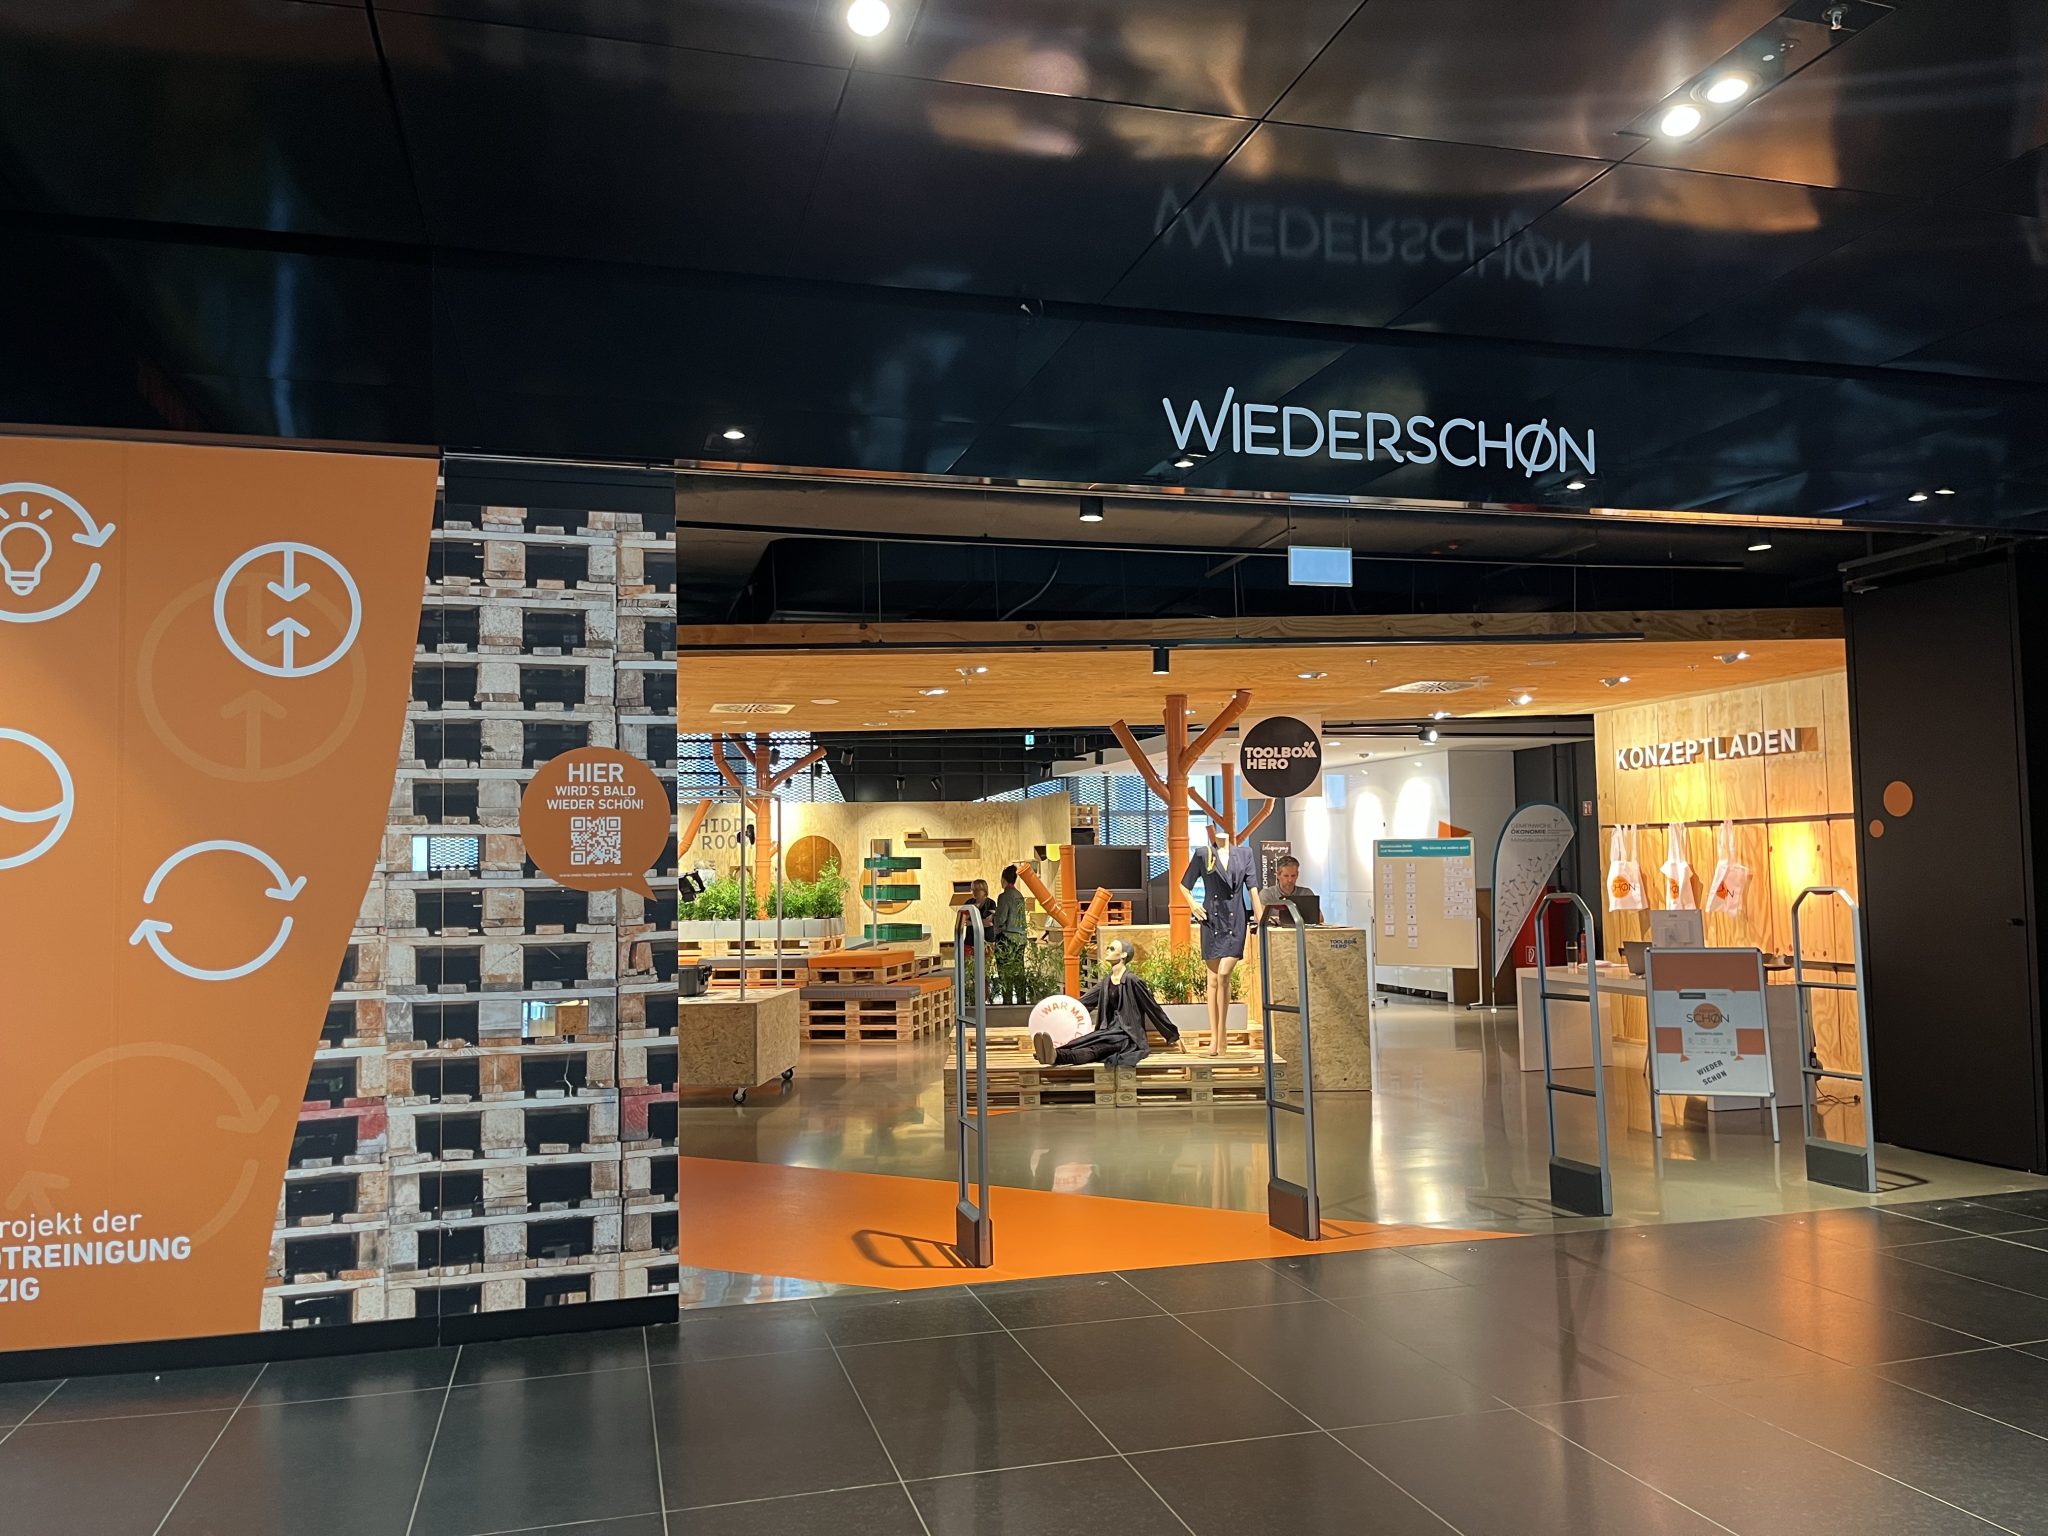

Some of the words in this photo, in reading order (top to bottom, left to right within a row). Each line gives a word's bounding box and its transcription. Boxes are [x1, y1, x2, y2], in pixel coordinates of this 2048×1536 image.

[1244, 741, 1317, 758] TOOLBOX
[1615, 727, 1796, 770] KONZEPTLADEN
[1246, 758, 1289, 770] HERO
[568, 763, 624, 783] HIER
[603, 785, 636, 796] BALD
[547, 799, 595, 810] WIEDER
[598, 796, 644, 810] SCHÖN!
[702, 834, 753, 850] ROO
[1696, 1060, 1724, 1076] WIEDER
[93, 1210, 142, 1233] der
[0, 1236, 191, 1270] TREINIGUNG
